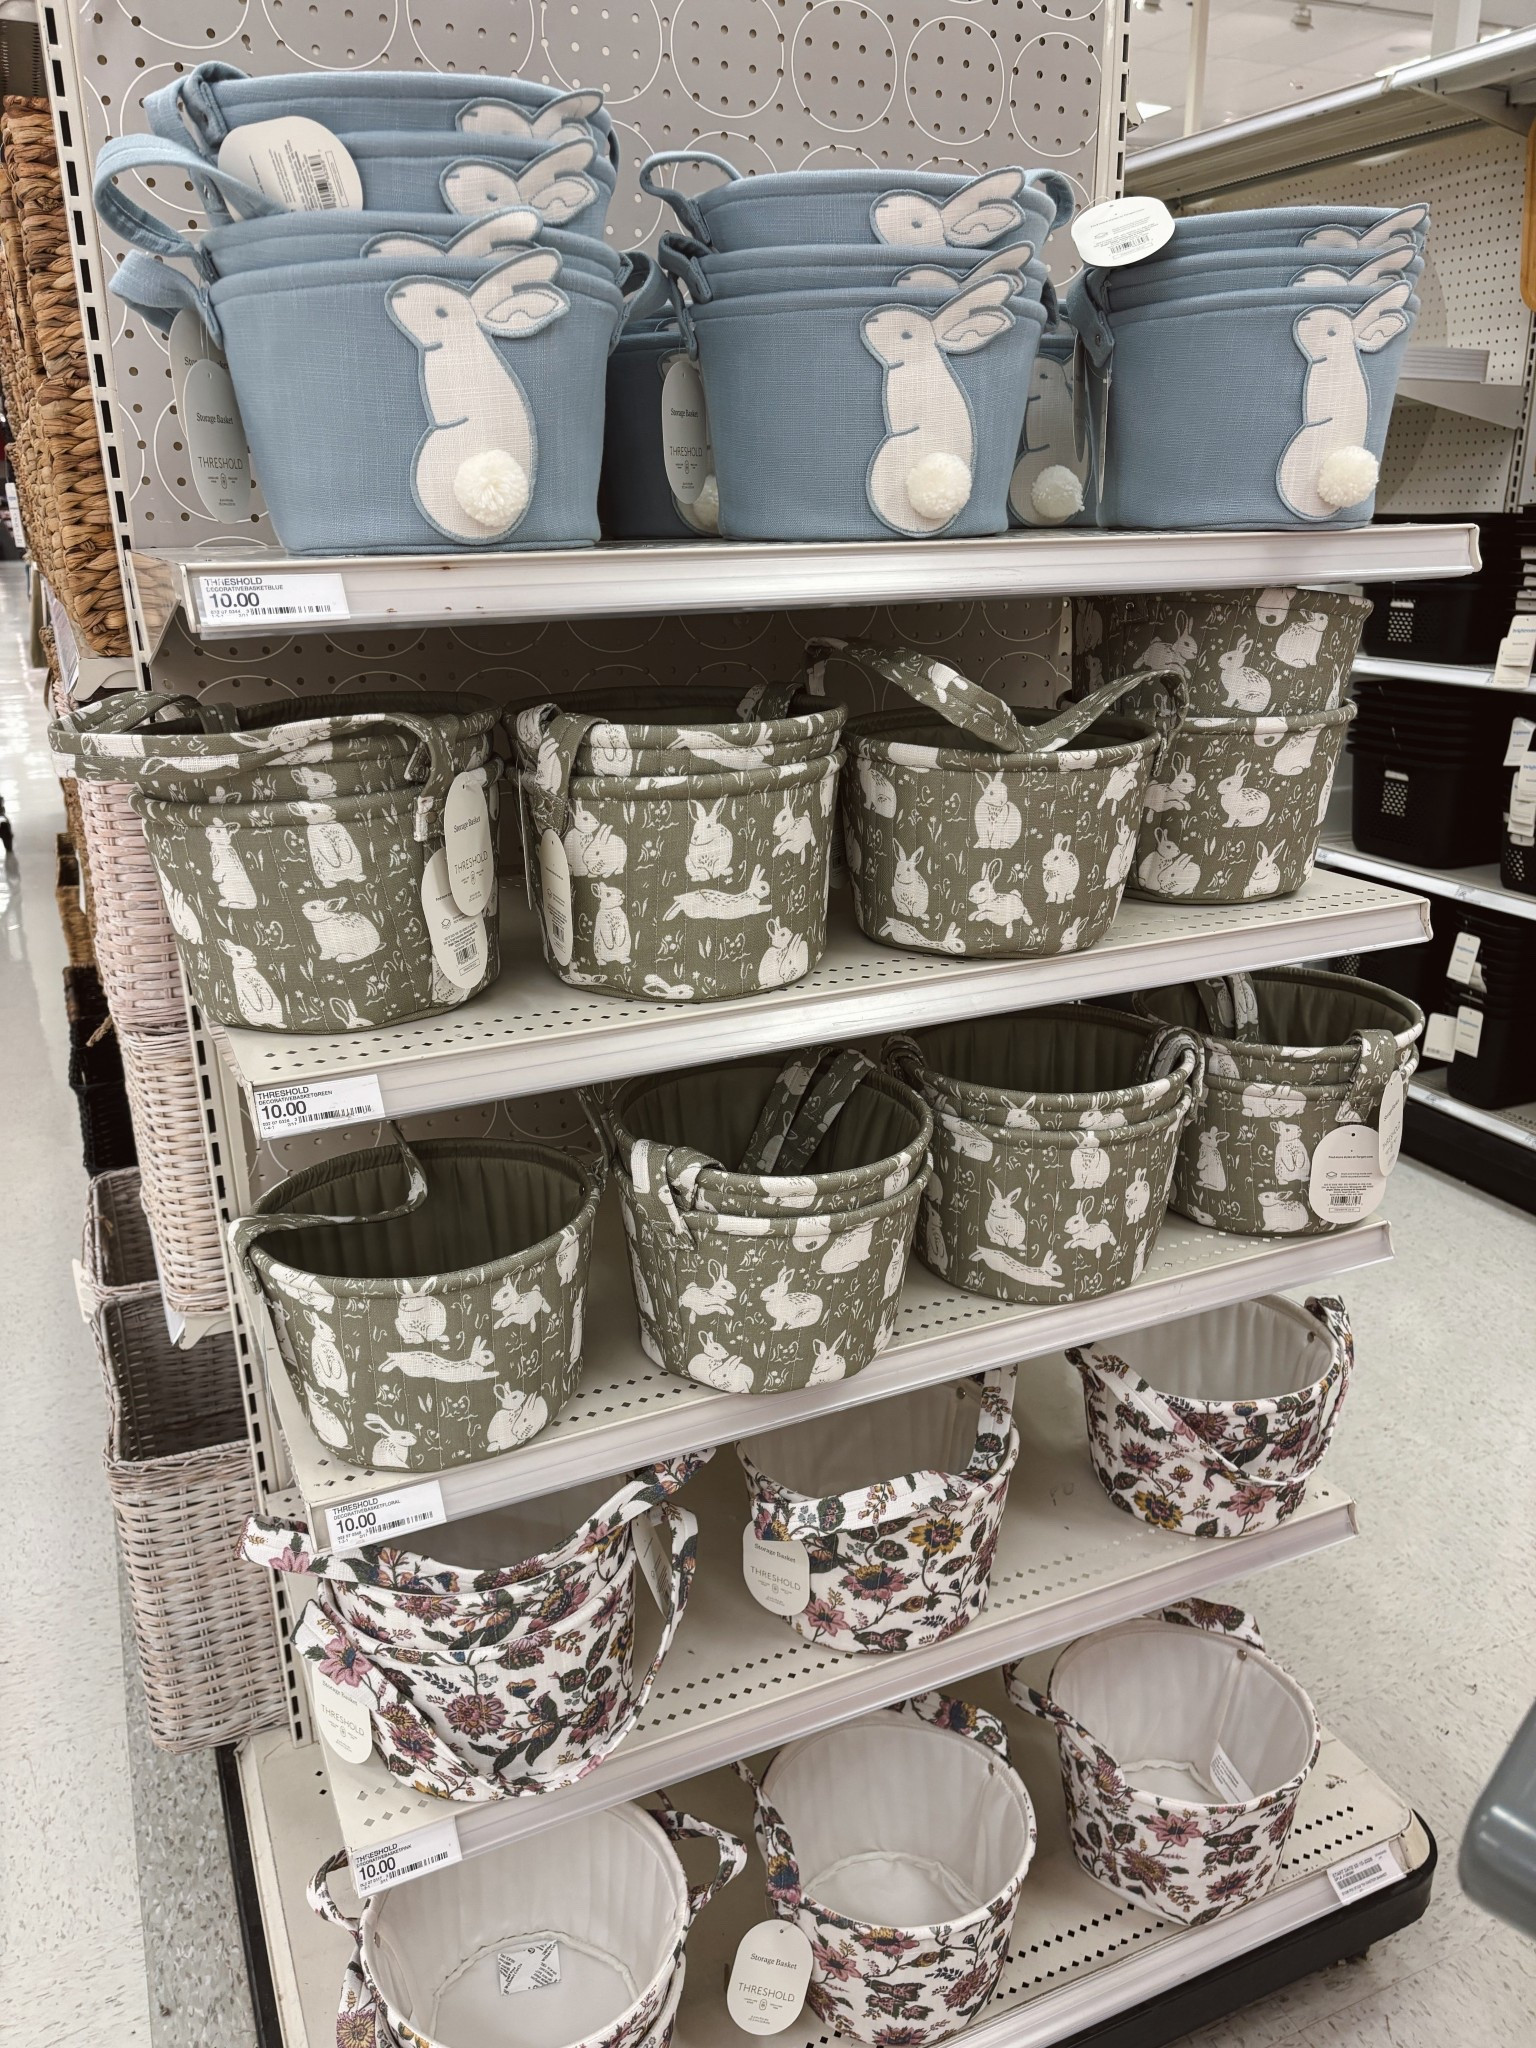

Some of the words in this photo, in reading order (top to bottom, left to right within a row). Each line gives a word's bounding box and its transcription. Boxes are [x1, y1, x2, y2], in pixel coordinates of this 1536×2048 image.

[196, 412, 217, 425] Storage
[217, 414, 234, 425] Basket
[670, 407, 685, 419] Storage
[685, 409, 699, 418] Basket
[670, 446, 703, 457] THRESHOLD
[198, 456, 244, 470] THRESHOLD
[204, 577, 263, 586] THRESHOLD
[209, 592, 260, 609] 10.00
[453, 821, 469, 833] Storage
[468, 816, 481, 827] Basket
[454, 850, 489, 874] THRESHOLD
[257, 1086, 310, 1101] THRESHOLD
[261, 1101, 307, 1120] 10.00
[332, 1497, 379, 1516] THRESHOLD
[336, 1512, 377, 1534] 10.00
[754, 1543, 776, 1557] Storage
[776, 1551, 796, 1563] Basket
[750, 1565, 801, 1591] THRESHOLD
[322, 1680, 341, 1696] Storage
[321, 1704, 365, 1737] THRESHOLD
[356, 1843, 398, 1862] THRESHOLD
[359, 1856, 396, 1881] 10.00
[750, 1952, 775, 1965] Storage
[775, 1958, 797, 1970] Basket
[738, 1982, 795, 2003] THRESHOLD
